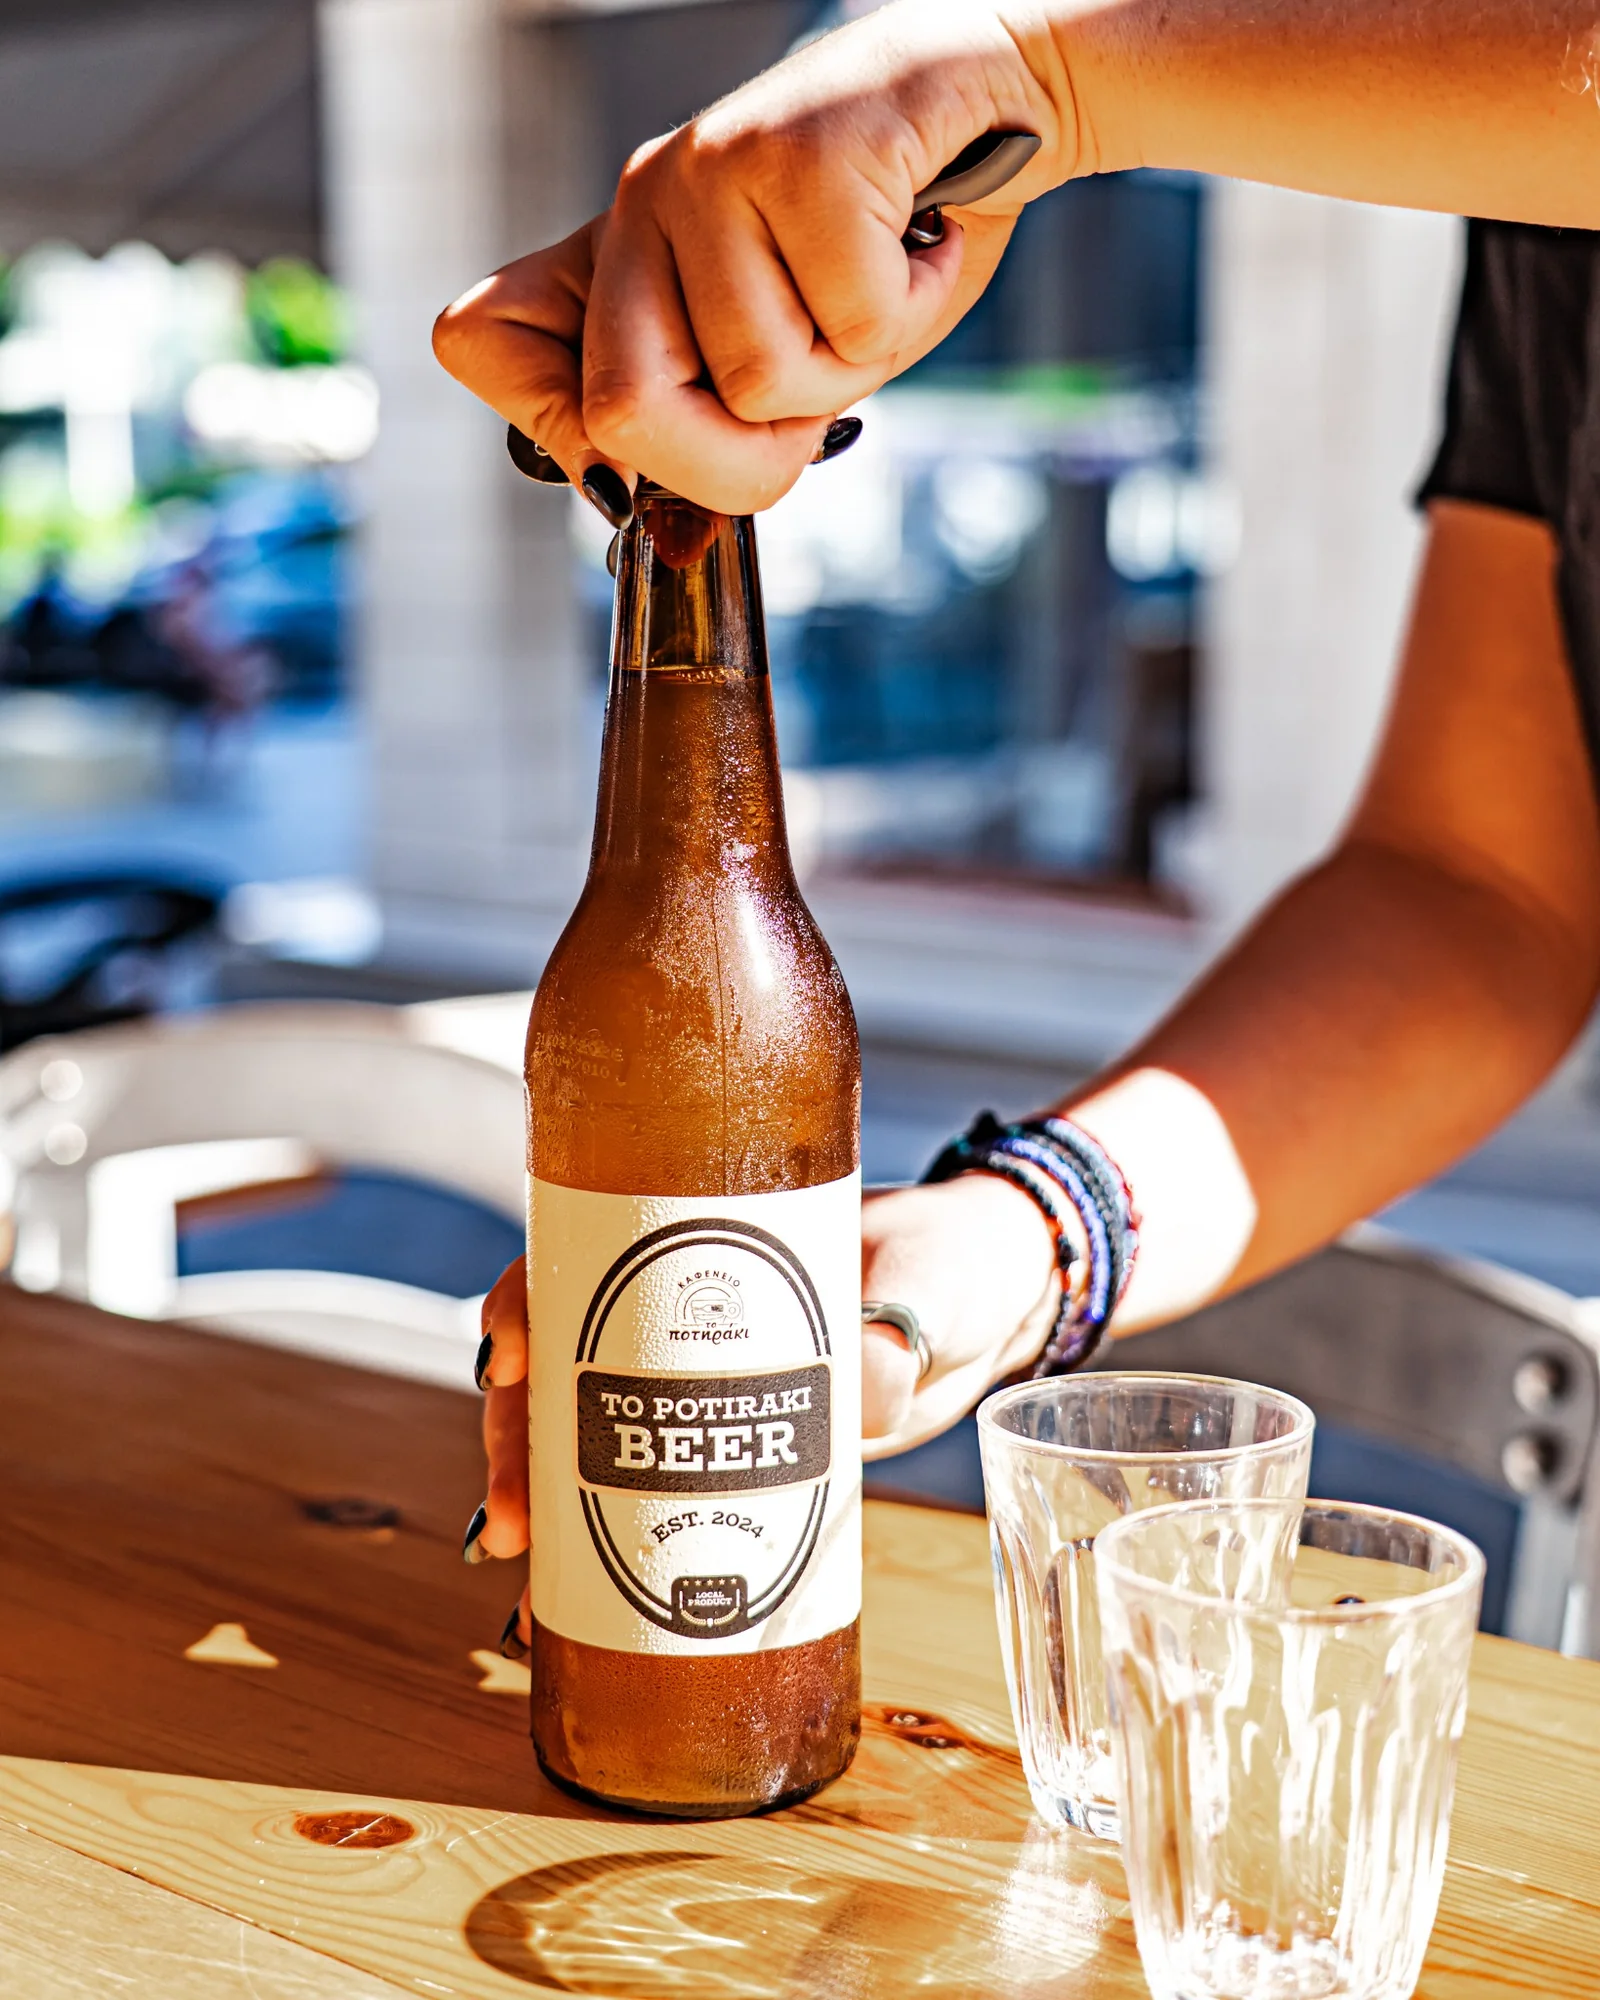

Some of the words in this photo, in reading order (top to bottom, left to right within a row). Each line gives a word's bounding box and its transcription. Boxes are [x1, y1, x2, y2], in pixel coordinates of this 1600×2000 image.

[677, 1270, 741, 1289] ΚΑΦΕΝΕΙΟ
[669, 1322, 750, 1345] ποτηράκι
[601, 1392, 645, 1419] TO
[652, 1386, 812, 1421] POTIRAKI
[614, 1420, 799, 1472] BEER
[651, 1511, 704, 1543] EST.
[711, 1511, 764, 1539] 2024
[687, 1597, 733, 1607] PRODUCT
[695, 1591, 725, 1599] LOCAL
